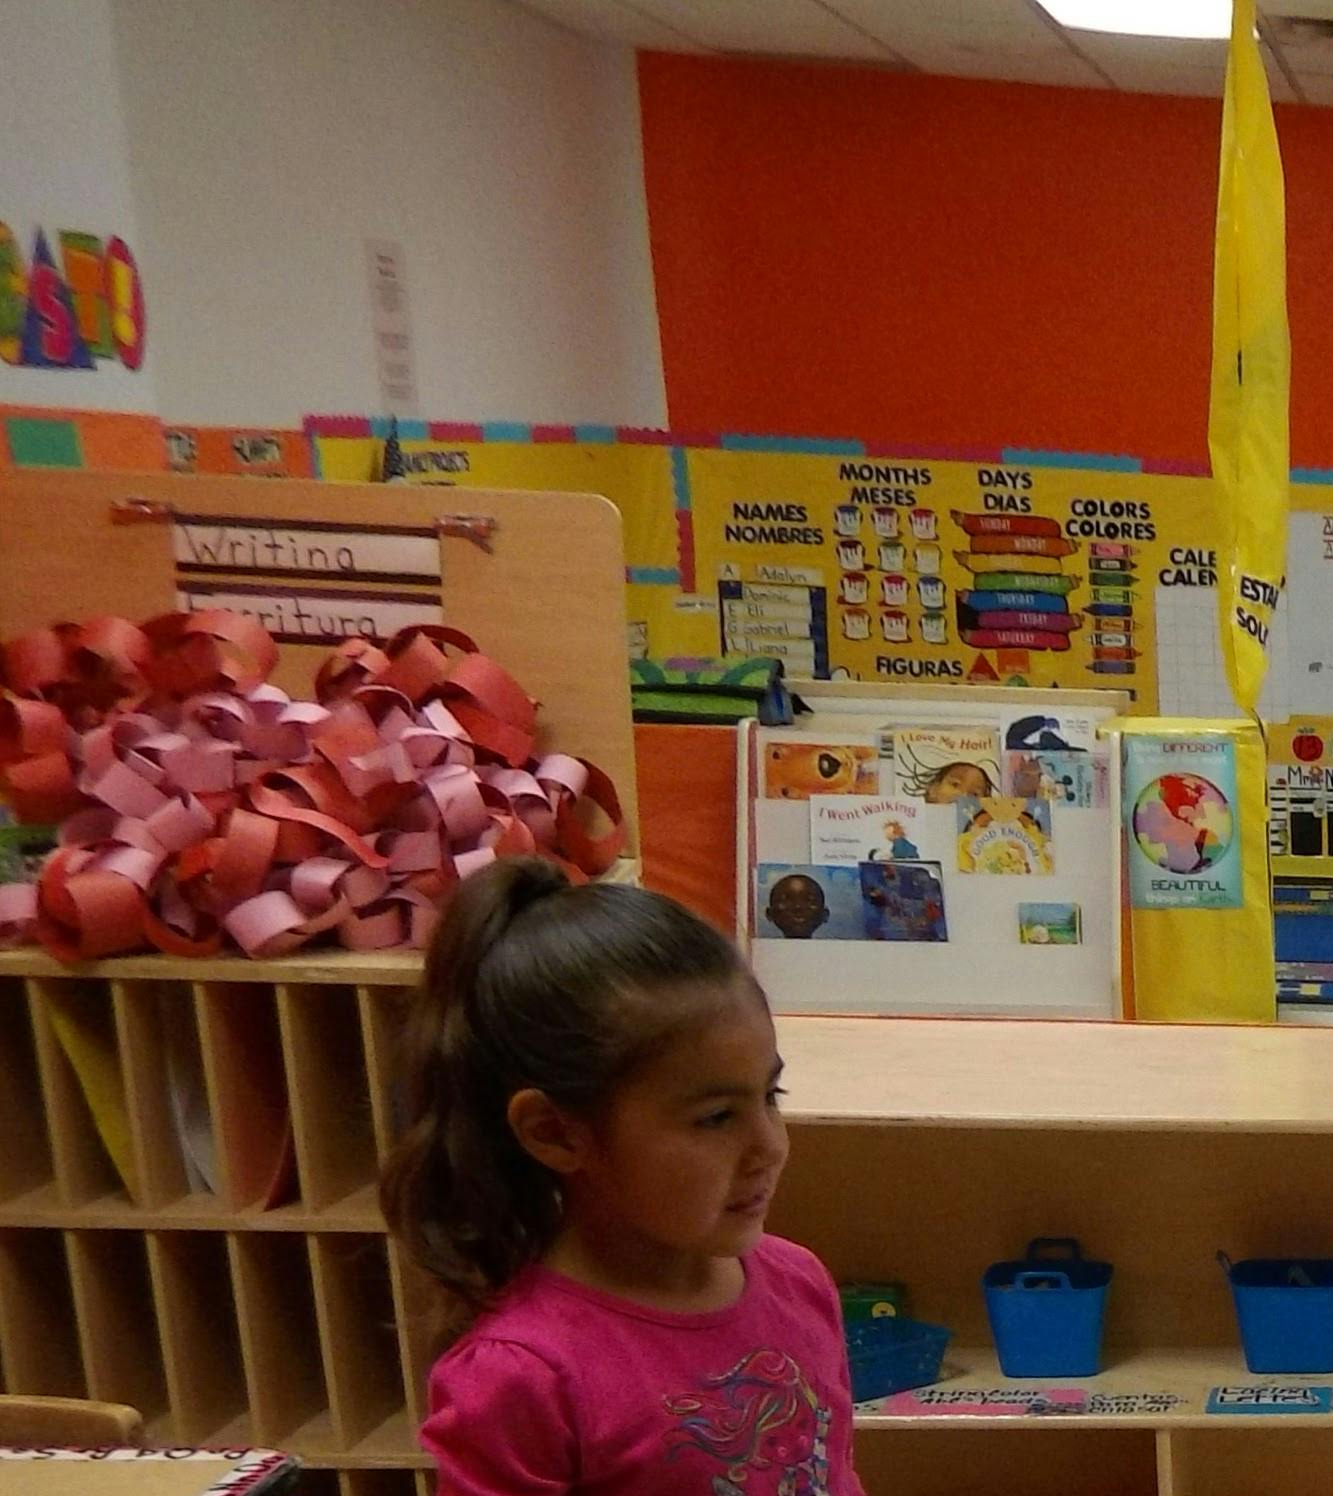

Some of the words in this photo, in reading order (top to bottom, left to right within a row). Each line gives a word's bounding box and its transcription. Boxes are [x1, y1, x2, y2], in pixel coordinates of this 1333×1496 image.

[839, 463, 932, 486] MONTHS
[978, 469, 1033, 490] DAYS
[851, 486, 917, 507] MESES
[984, 493, 1031, 513] DIAS
[733, 502, 808, 523] NAMES
[1071, 499, 1150, 520] COLORS
[725, 524, 824, 545] NOMBRES
[1066, 519, 1156, 541] COLORES
[181, 523, 356, 571] Writing
[876, 656, 963, 677] FIGURAS
[909, 733, 935, 745] Love
[940, 735, 954, 750] My
[959, 736, 993, 751] Hair!
[1162, 742, 1228, 754] DIFFERENT
[826, 808, 860, 821] Went
[862, 801, 917, 819] Walking
[973, 829, 997, 857] GOOD
[1151, 879, 1227, 892] BEAUTIFUL
